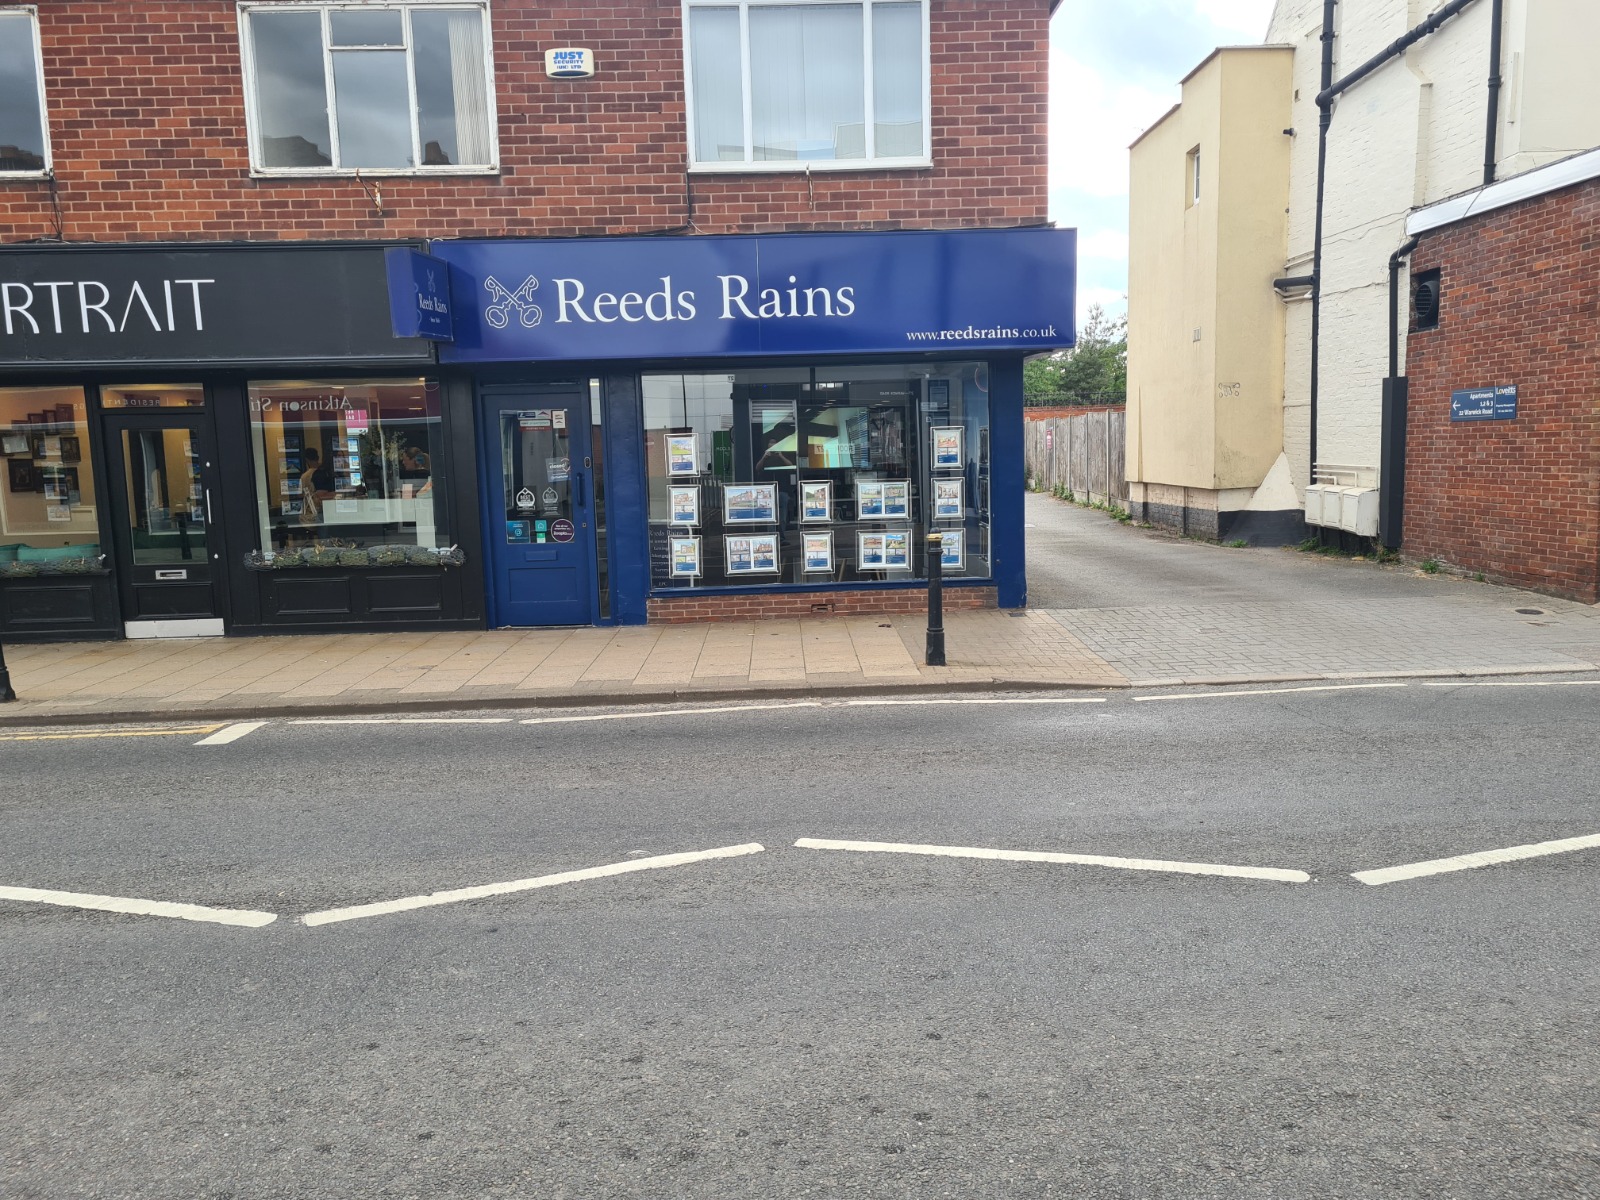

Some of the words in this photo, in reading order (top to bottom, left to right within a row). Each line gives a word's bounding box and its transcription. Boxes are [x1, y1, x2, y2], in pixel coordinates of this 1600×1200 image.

[553, 51, 584, 60] JUST
[1, 279, 215, 335] RTRAIT
[418, 293, 434, 311] Reeds
[433, 296, 448, 314] Rains
[552, 275, 697, 323] Reeds
[716, 274, 855, 320] Rains
[906, 324, 1058, 341] www.reedsrains.co.uk
[1470, 392, 1493, 400] Apartments
